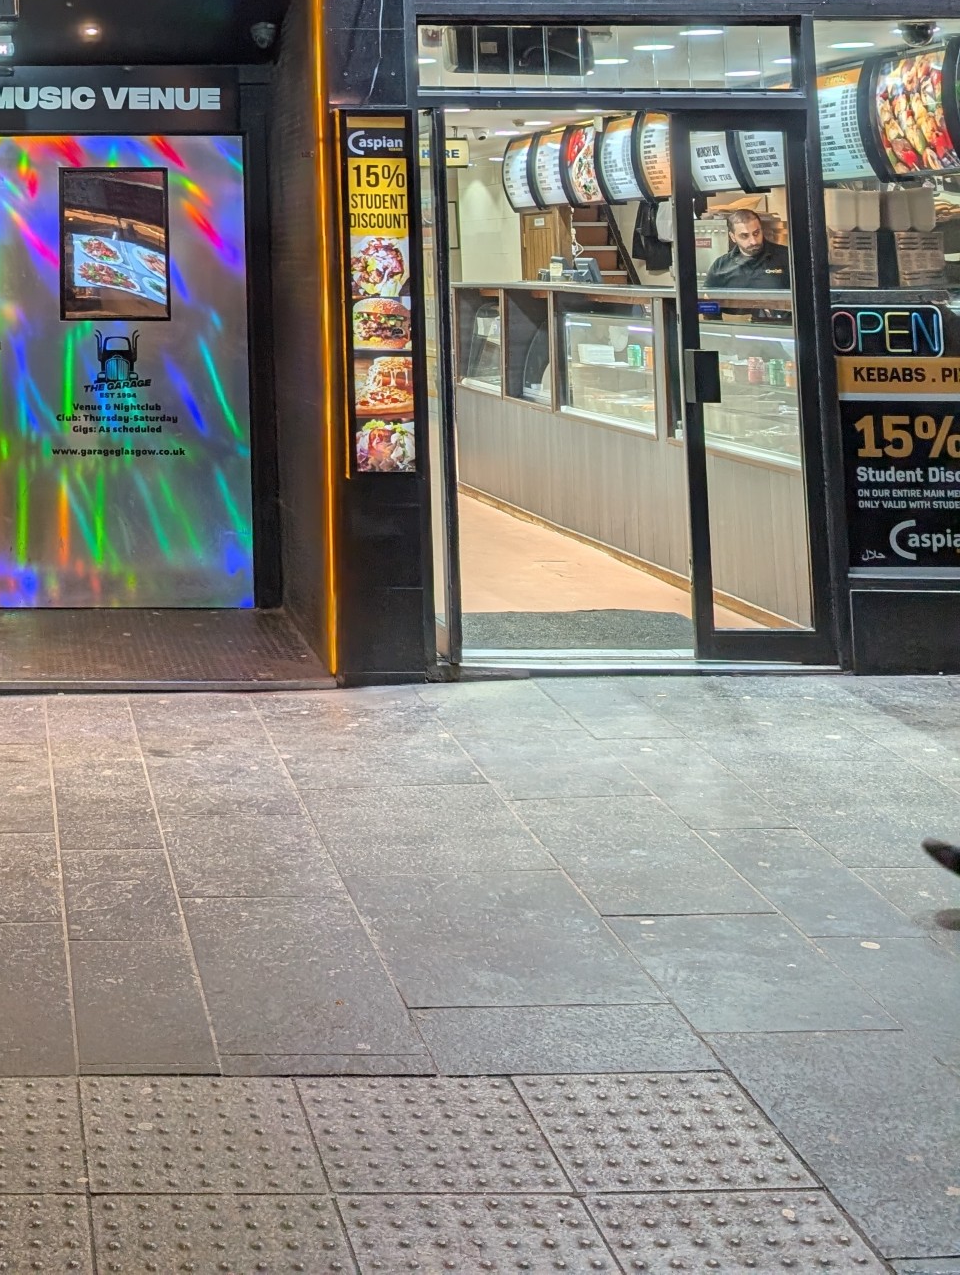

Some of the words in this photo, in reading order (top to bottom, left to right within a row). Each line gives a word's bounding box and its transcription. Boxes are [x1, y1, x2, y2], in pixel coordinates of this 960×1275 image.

[102, 87, 221, 111] VENUE
[348, 130, 404, 155] Caspian
[421, 149, 460, 159] HRE
[352, 165, 406, 188] 15%
[351, 193, 406, 210] STUDENT
[350, 212, 409, 228] DISCOUNT
[831, 311, 939, 352] OPEN
[853, 367, 927, 382] KEBABS
[942, 367, 960, 382] PI
[84, 383, 106, 392] THE
[107, 379, 152, 391] GARAGE
[72, 403, 102, 411] Venue
[105, 403, 111, 411] &
[113, 403, 162, 413] Nightclub
[56, 414, 81, 422] Club:
[83, 414, 178, 424] Thursday-Saturday
[72, 425, 96, 435] Gigs:
[113, 425, 162, 433] scheduled
[854, 415, 960, 458] 15%
[52, 447, 186, 456] www.garageglasgow.co.uk
[856, 466, 924, 482] Student
[858, 489, 870, 497] ON
[872, 489, 890, 498] OUR
[892, 489, 922, 497] ENTIRE
[924, 489, 945, 497] MAIN
[858, 501, 880, 509] ONLY
[908, 501, 931, 509] WITH
[862, 549, 886, 561] حلال
